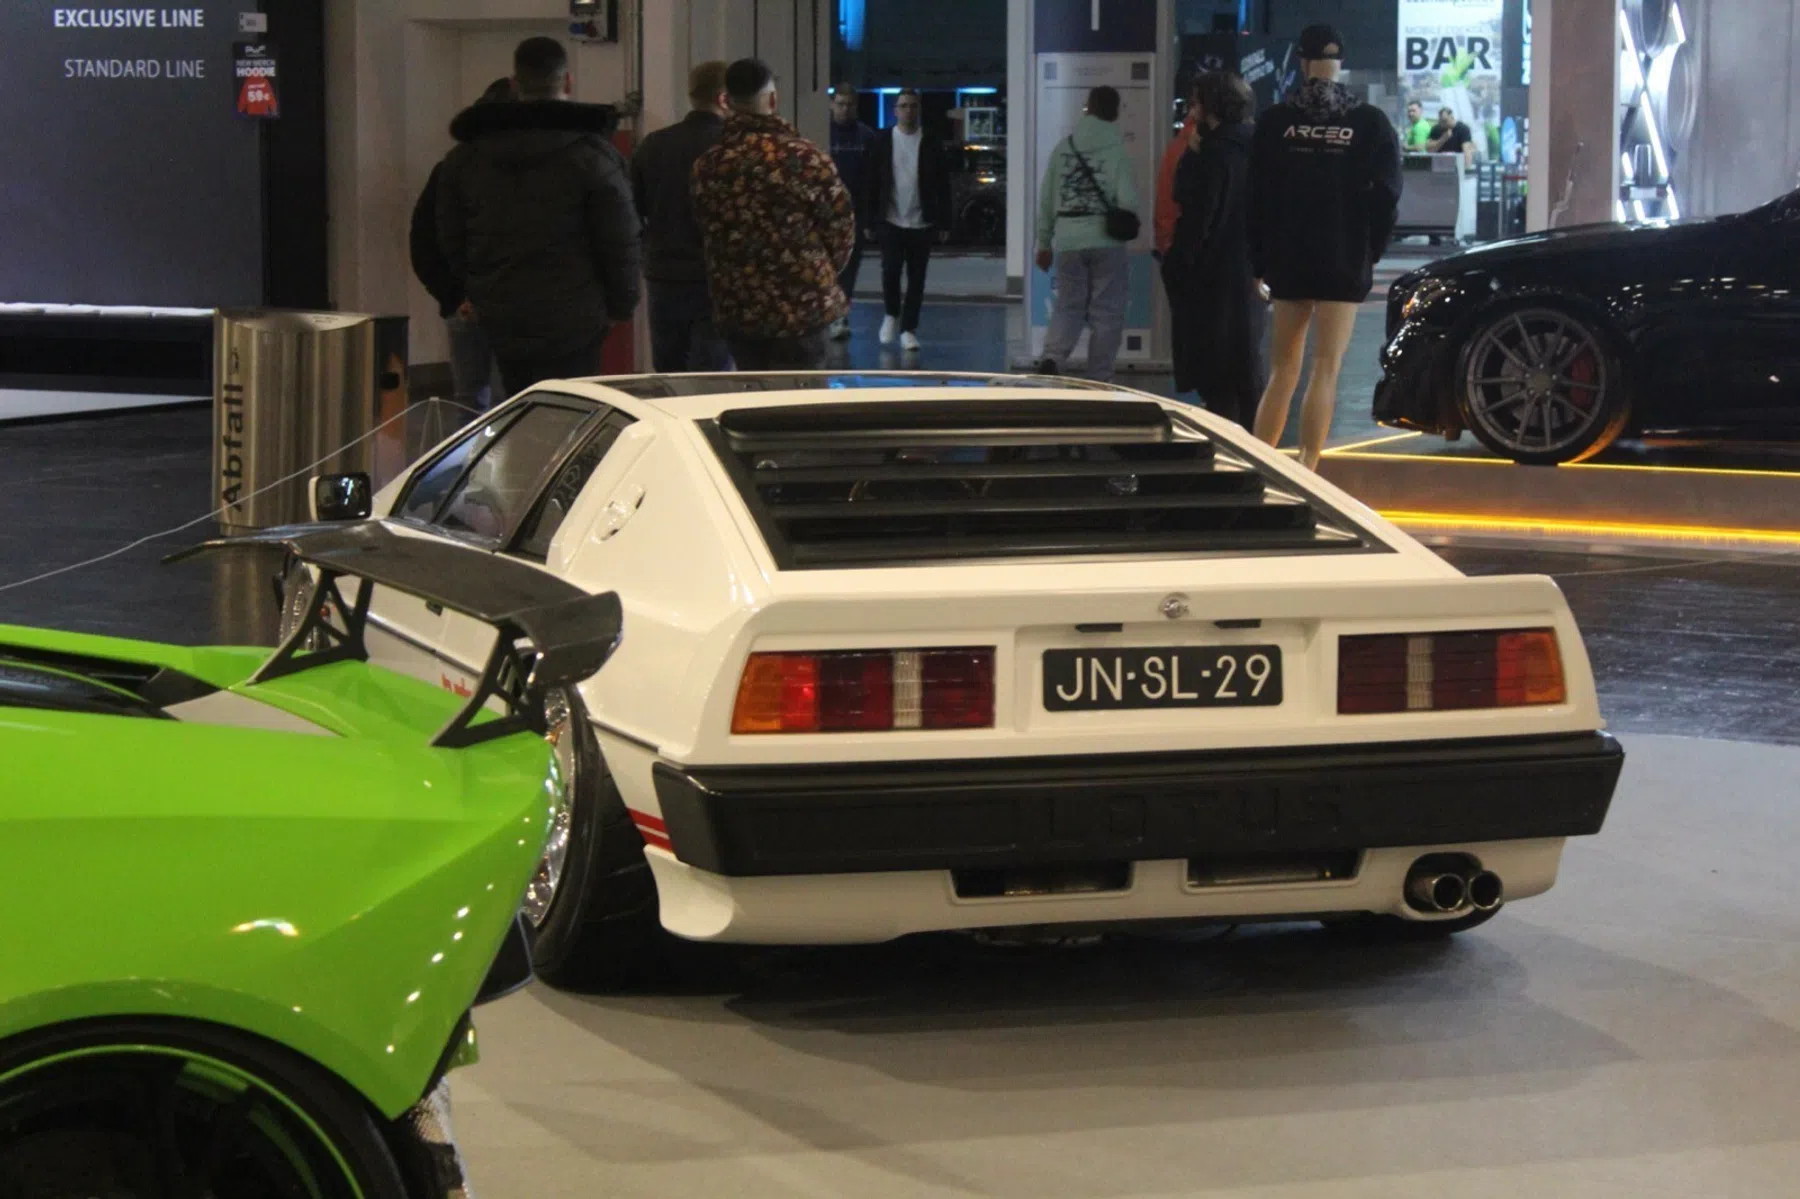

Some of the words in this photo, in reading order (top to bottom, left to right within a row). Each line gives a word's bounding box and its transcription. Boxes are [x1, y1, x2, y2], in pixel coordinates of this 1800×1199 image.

[54, 9, 156, 28] EXCLUSIVE
[161, 9, 205, 28] LINE
[1406, 36, 1493, 70] BAR
[64, 59, 160, 79] STANDARD
[166, 59, 206, 80] LINE
[236, 67, 276, 77] HOODIE
[1284, 125, 1354, 140] ARCEO
[222, 384, 244, 513] Abfall
